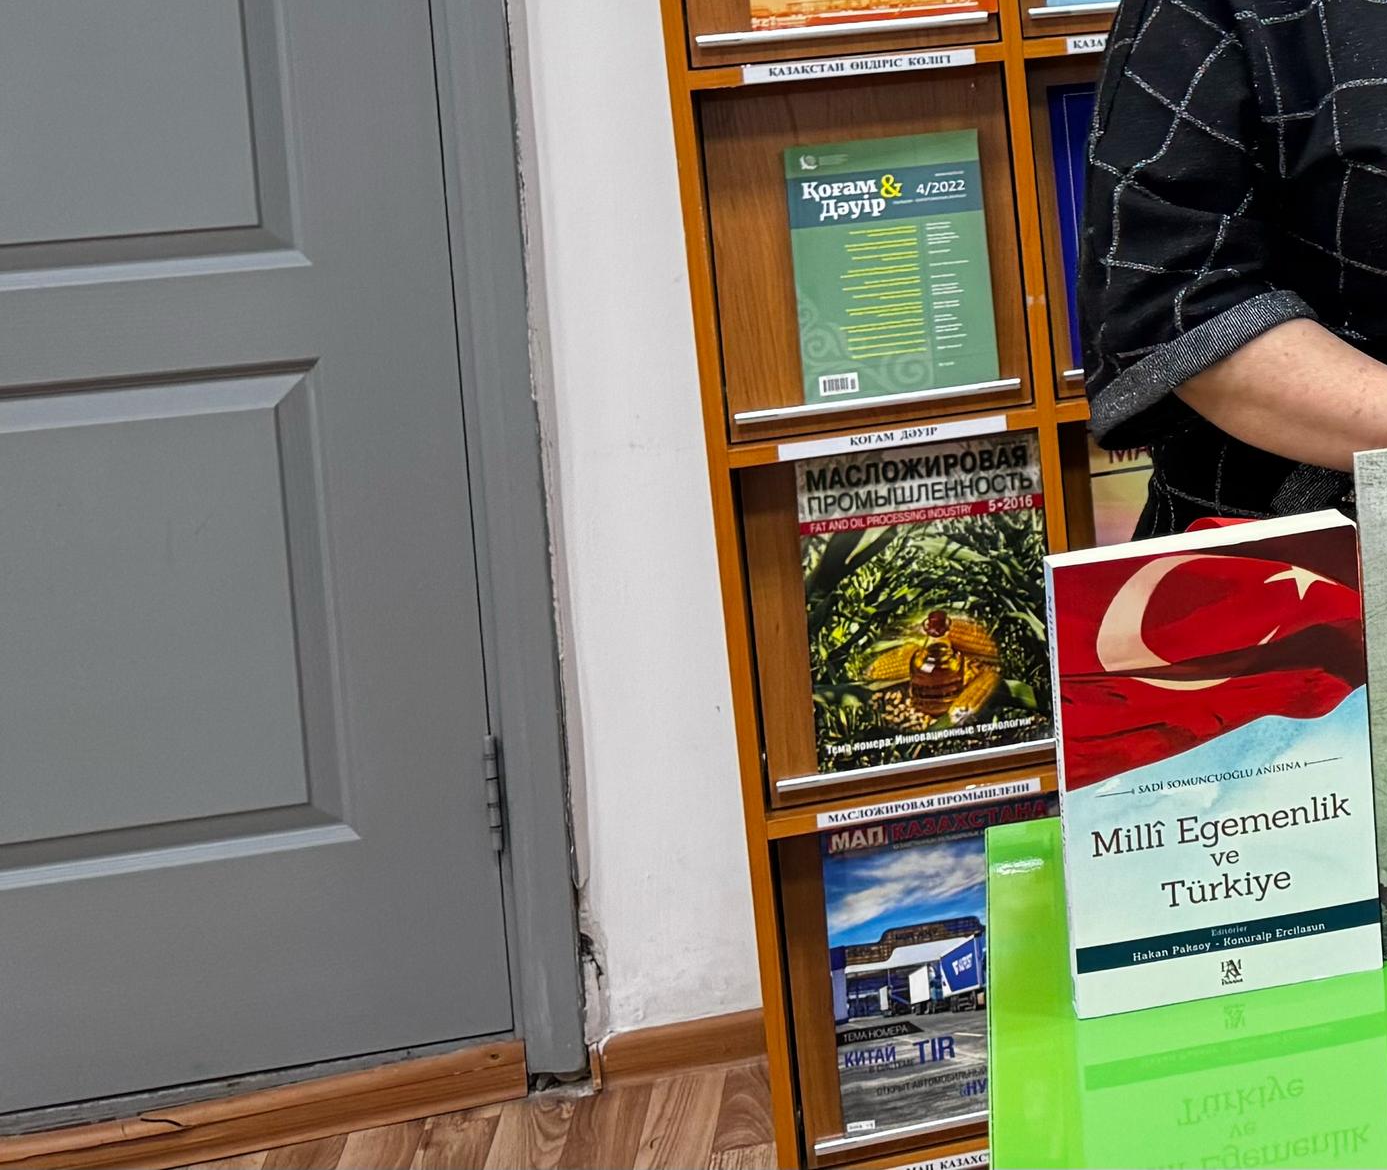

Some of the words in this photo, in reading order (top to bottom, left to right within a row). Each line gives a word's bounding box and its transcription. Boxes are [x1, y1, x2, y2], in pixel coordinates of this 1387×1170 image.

[801, 179, 878, 201] Қоғам
[880, 174, 902, 198] &
[916, 179, 965, 196] 4/2022
[820, 198, 886, 221] Дәуір
[900, 427, 937, 440] ДӘУІР
[806, 446, 1028, 492] МАСЛОЖИРОВАЯ
[808, 472, 1033, 515] ПРОМЫШЛЕННОСТЬ
[810, 522, 826, 533] FAT
[827, 519, 849, 531] AND
[850, 517, 867, 529] OIL
[868, 509, 927, 527] PROCESSING
[928, 505, 972, 521] INDUSTRY
[827, 743, 851, 755] Тема
[854, 736, 892, 751] номера:
[895, 723, 973, 746] Инновационные
[976, 716, 1033, 734] технологии
[1137, 781, 1164, 795] SADİ
[1166, 767, 1253, 792] SOMUNCUOĞLU
[1256, 760, 1301, 779] ANISINA
[828, 797, 934, 824] МАСЛОЖИРОВАЯ
[829, 829, 884, 853] МАП
[891, 801, 1048, 840] КАЗАХСТАНА
[1091, 821, 1165, 859] Millî
[1177, 793, 1351, 851] Egemenlik
[1210, 848, 1240, 866] ve
[1161, 867, 1292, 908] Türkiye
[1133, 947, 1169, 961] Hakan
[1173, 940, 1211, 957] Paksoy
[1224, 929, 1273, 949] Konuralp
[1275, 921, 1325, 939] Ercilasun
[843, 1045, 897, 1068] КИТАЙ
[919, 1036, 955, 1064] TIR
